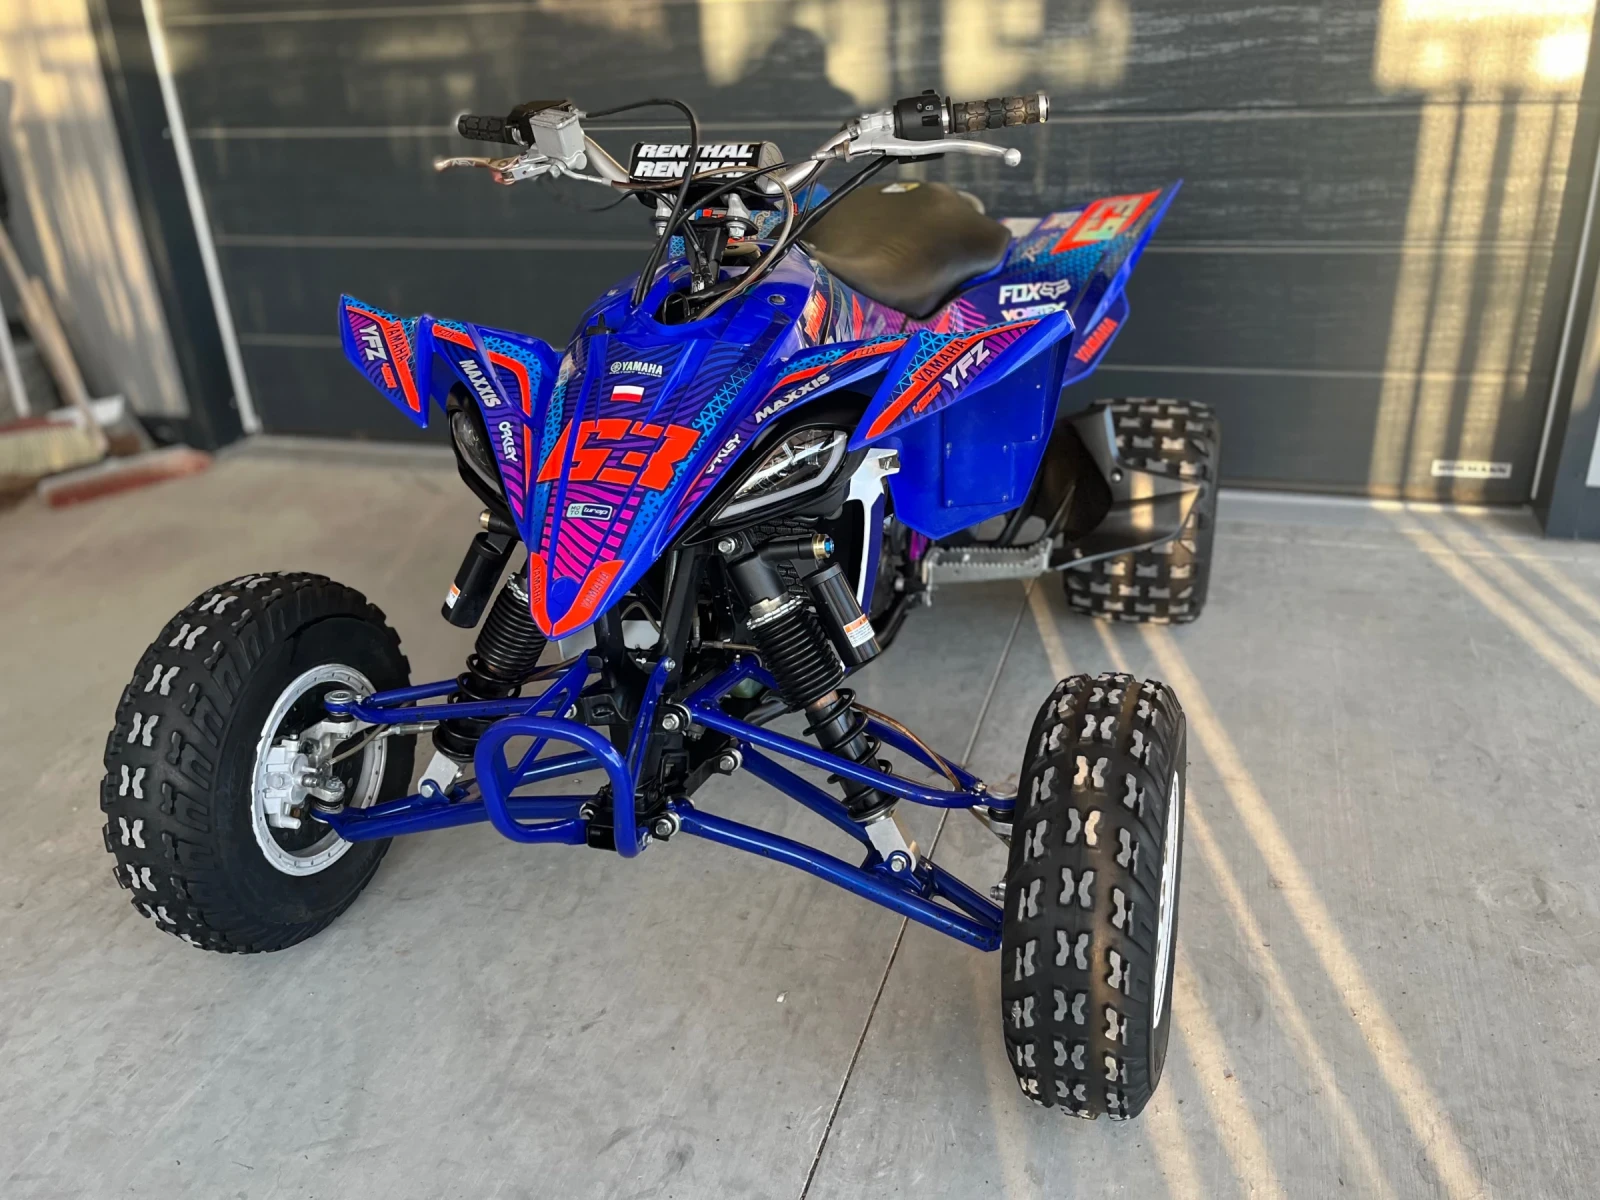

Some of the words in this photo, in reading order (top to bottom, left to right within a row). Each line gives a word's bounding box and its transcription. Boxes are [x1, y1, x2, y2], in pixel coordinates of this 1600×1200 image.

[999, 283, 1042, 305] FOX
[359, 324, 388, 361] YFZ
[386, 322, 409, 363] YAMAHA
[914, 339, 967, 382] YAMAHA
[1074, 317, 1118, 363] YAMAHA
[459, 359, 502, 408] MAXXIS
[622, 361, 663, 375] YAMAHA
[942, 339, 990, 389] YFZ
[755, 373, 830, 424] MAXXIS
[537, 418, 701, 491] 63
[533, 565, 542, 605] YAMAHA
[581, 571, 610, 609] YAMAHA
